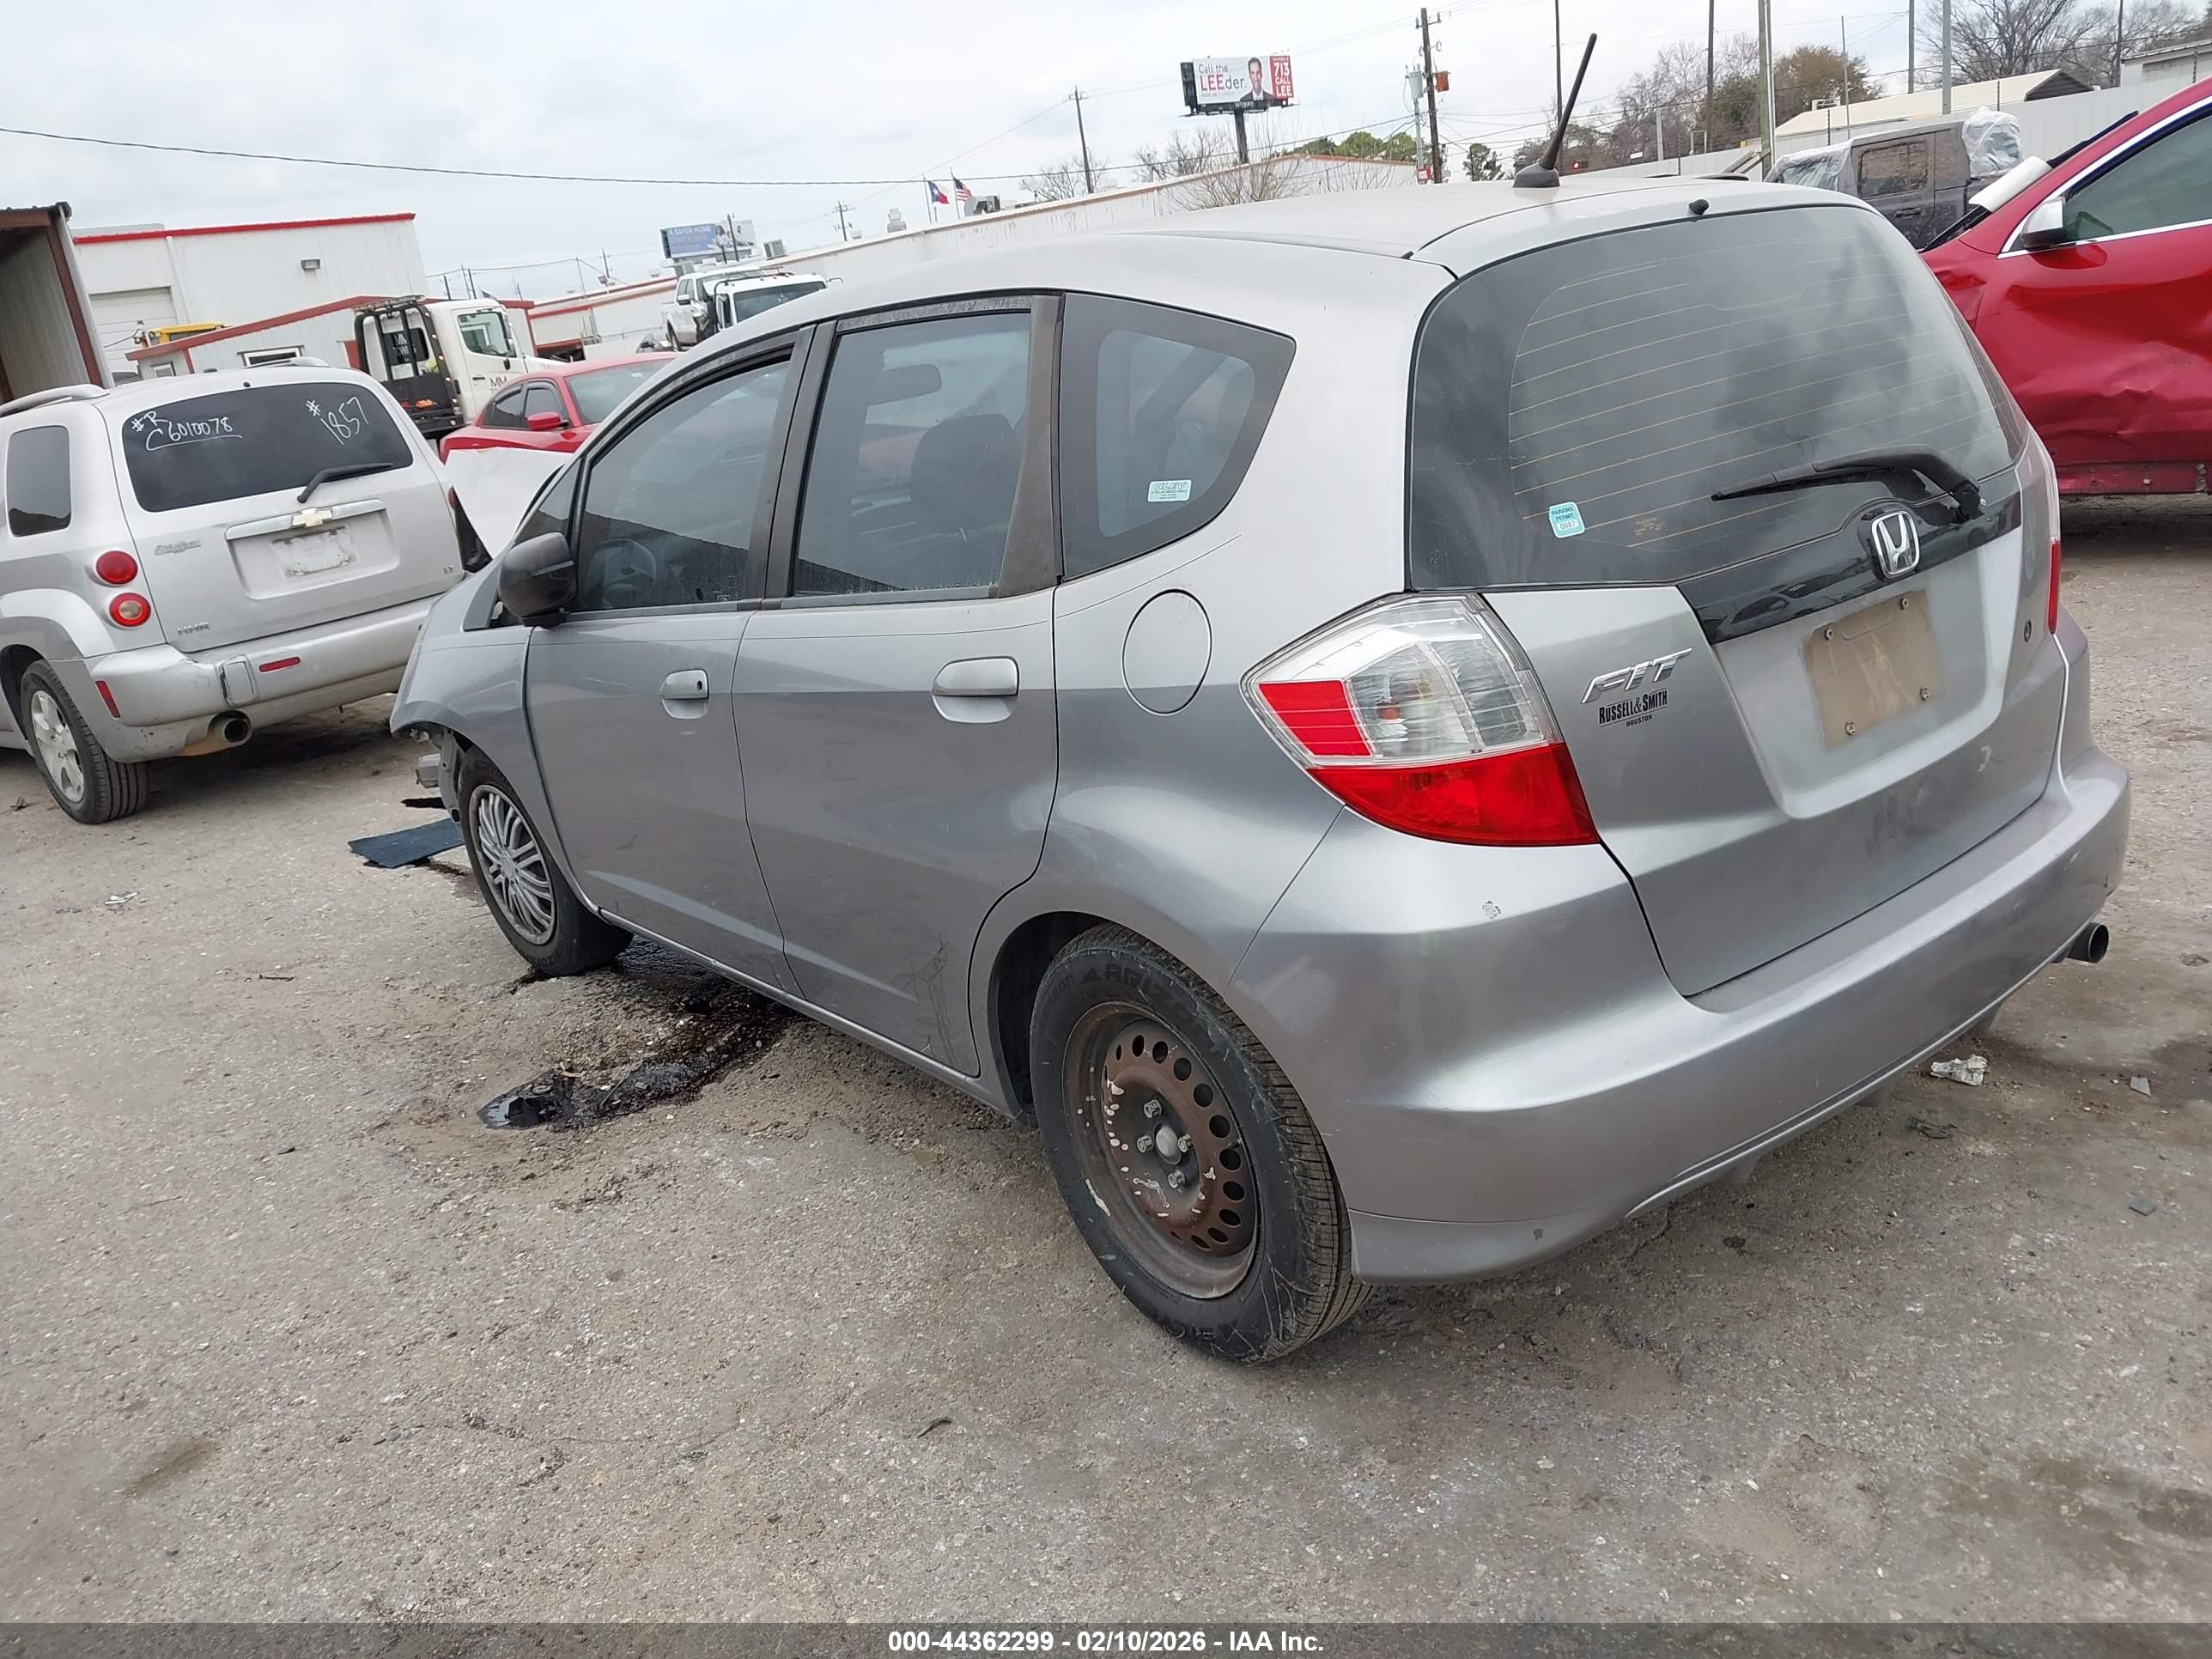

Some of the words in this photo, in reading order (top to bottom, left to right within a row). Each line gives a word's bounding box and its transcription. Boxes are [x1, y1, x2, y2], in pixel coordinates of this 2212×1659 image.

[1198, 64, 1212, 74] Call
[1215, 63, 1228, 72] the
[1273, 61, 1290, 77] 713
[1200, 74, 1248, 91] LEEder.
[1275, 84, 1292, 97] LEE
[1551, 507, 1574, 516] PARKING
[1555, 513, 1574, 521] PERMIT
[1580, 647, 1692, 704] FIT
[1626, 714, 1654, 728] HOUSTON
